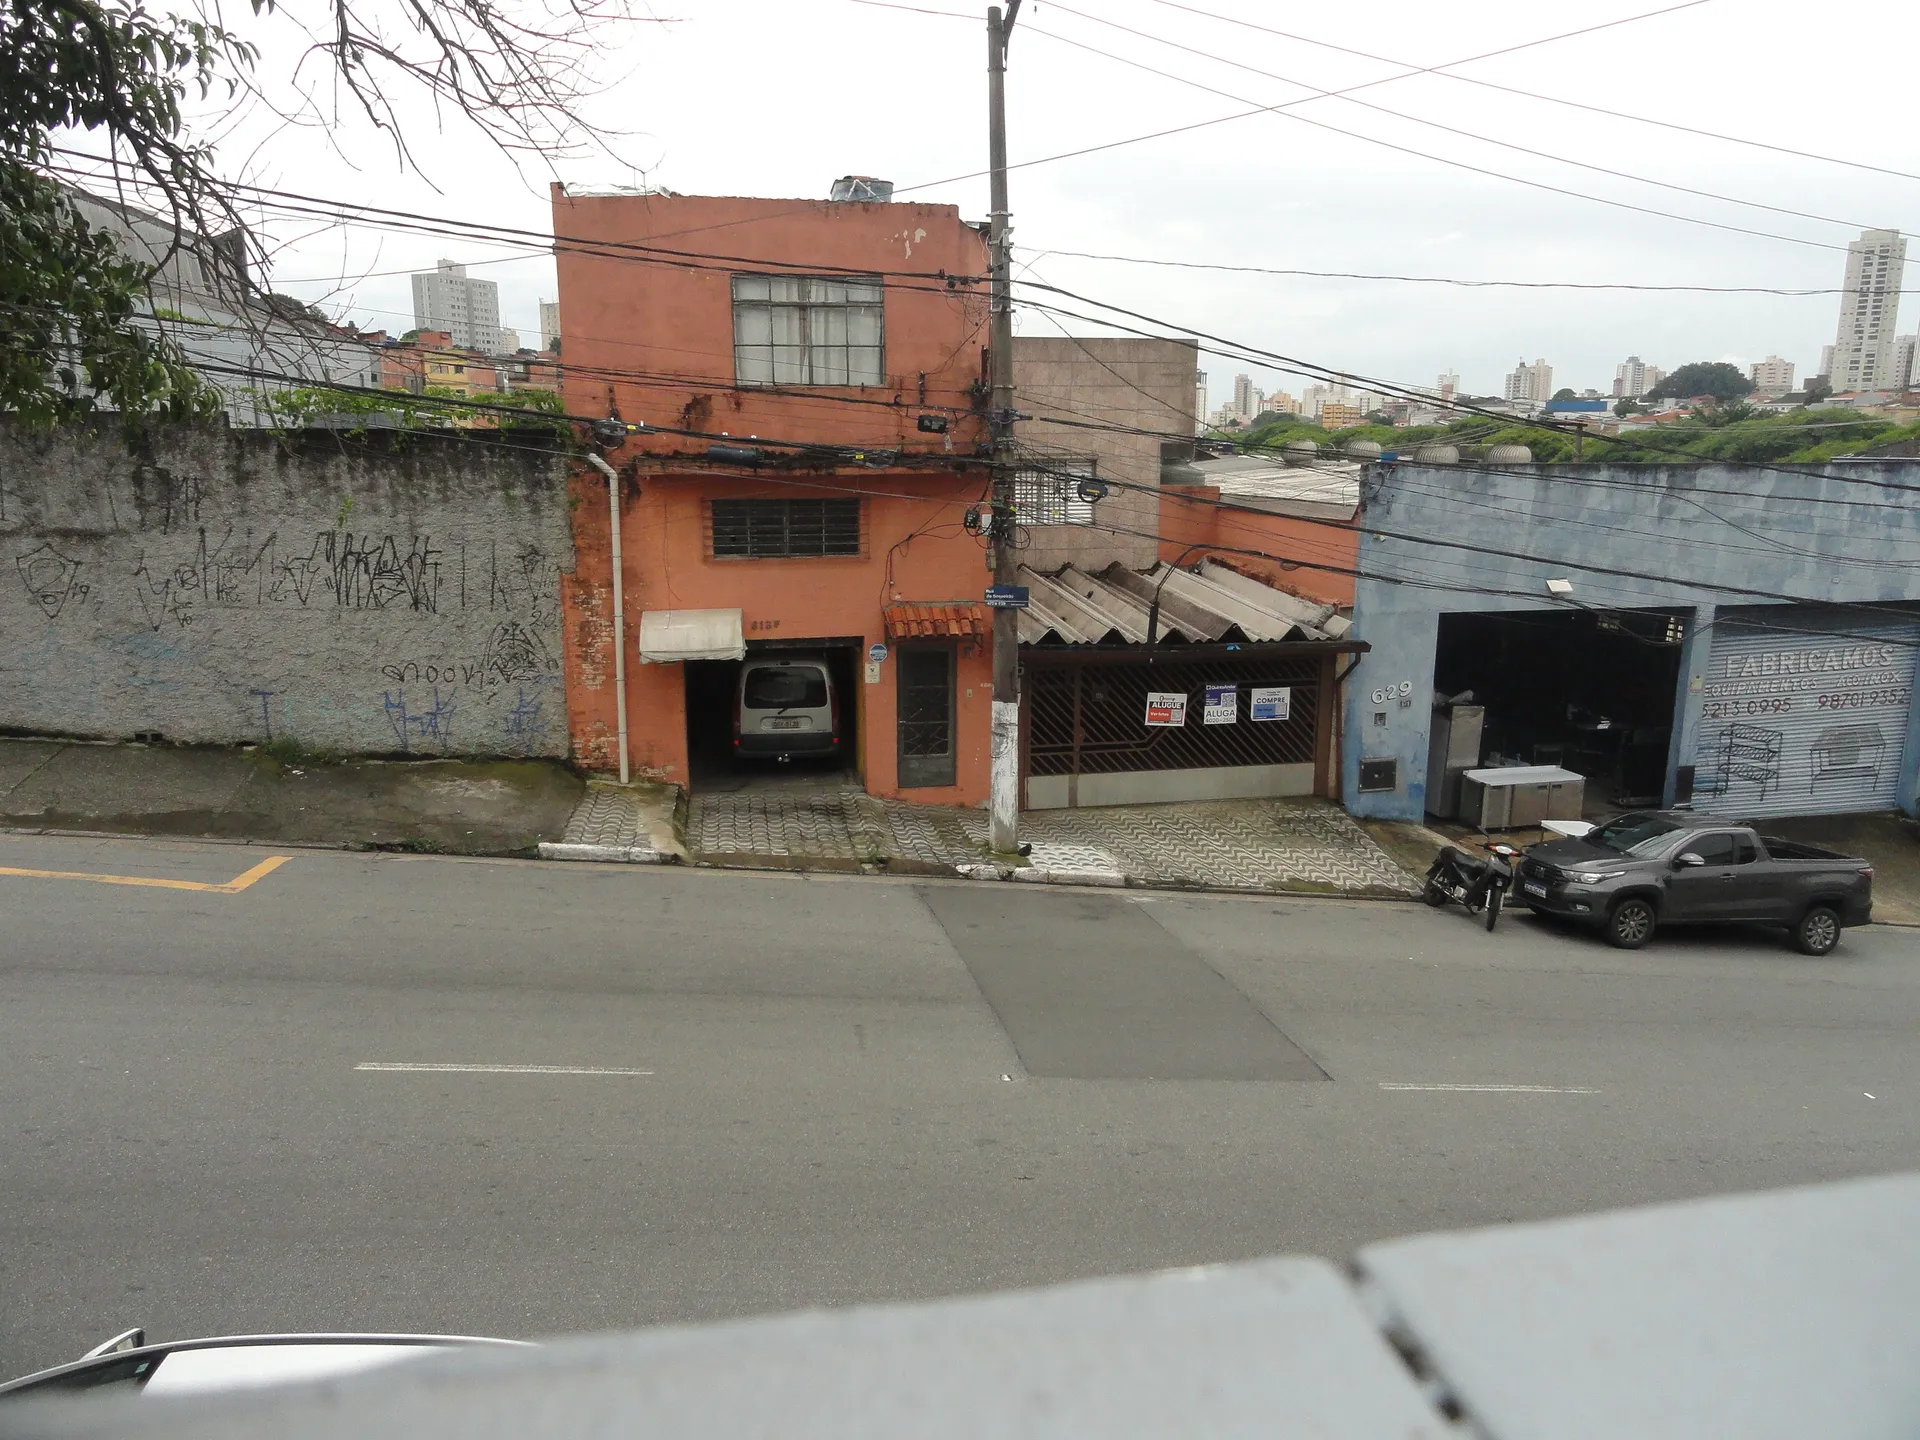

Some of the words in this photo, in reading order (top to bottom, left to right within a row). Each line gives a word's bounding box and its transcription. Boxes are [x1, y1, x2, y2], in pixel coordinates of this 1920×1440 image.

[1725, 644, 1894, 678] FABRICAMOS
[1371, 680, 1412, 705] 629
[1704, 676, 1818, 698] EQUIPAMENTOS
[1151, 701, 1182, 709] ALUGUE
[1256, 696, 1286, 704] COMPRE
[1205, 709, 1236, 718] ALUGA
